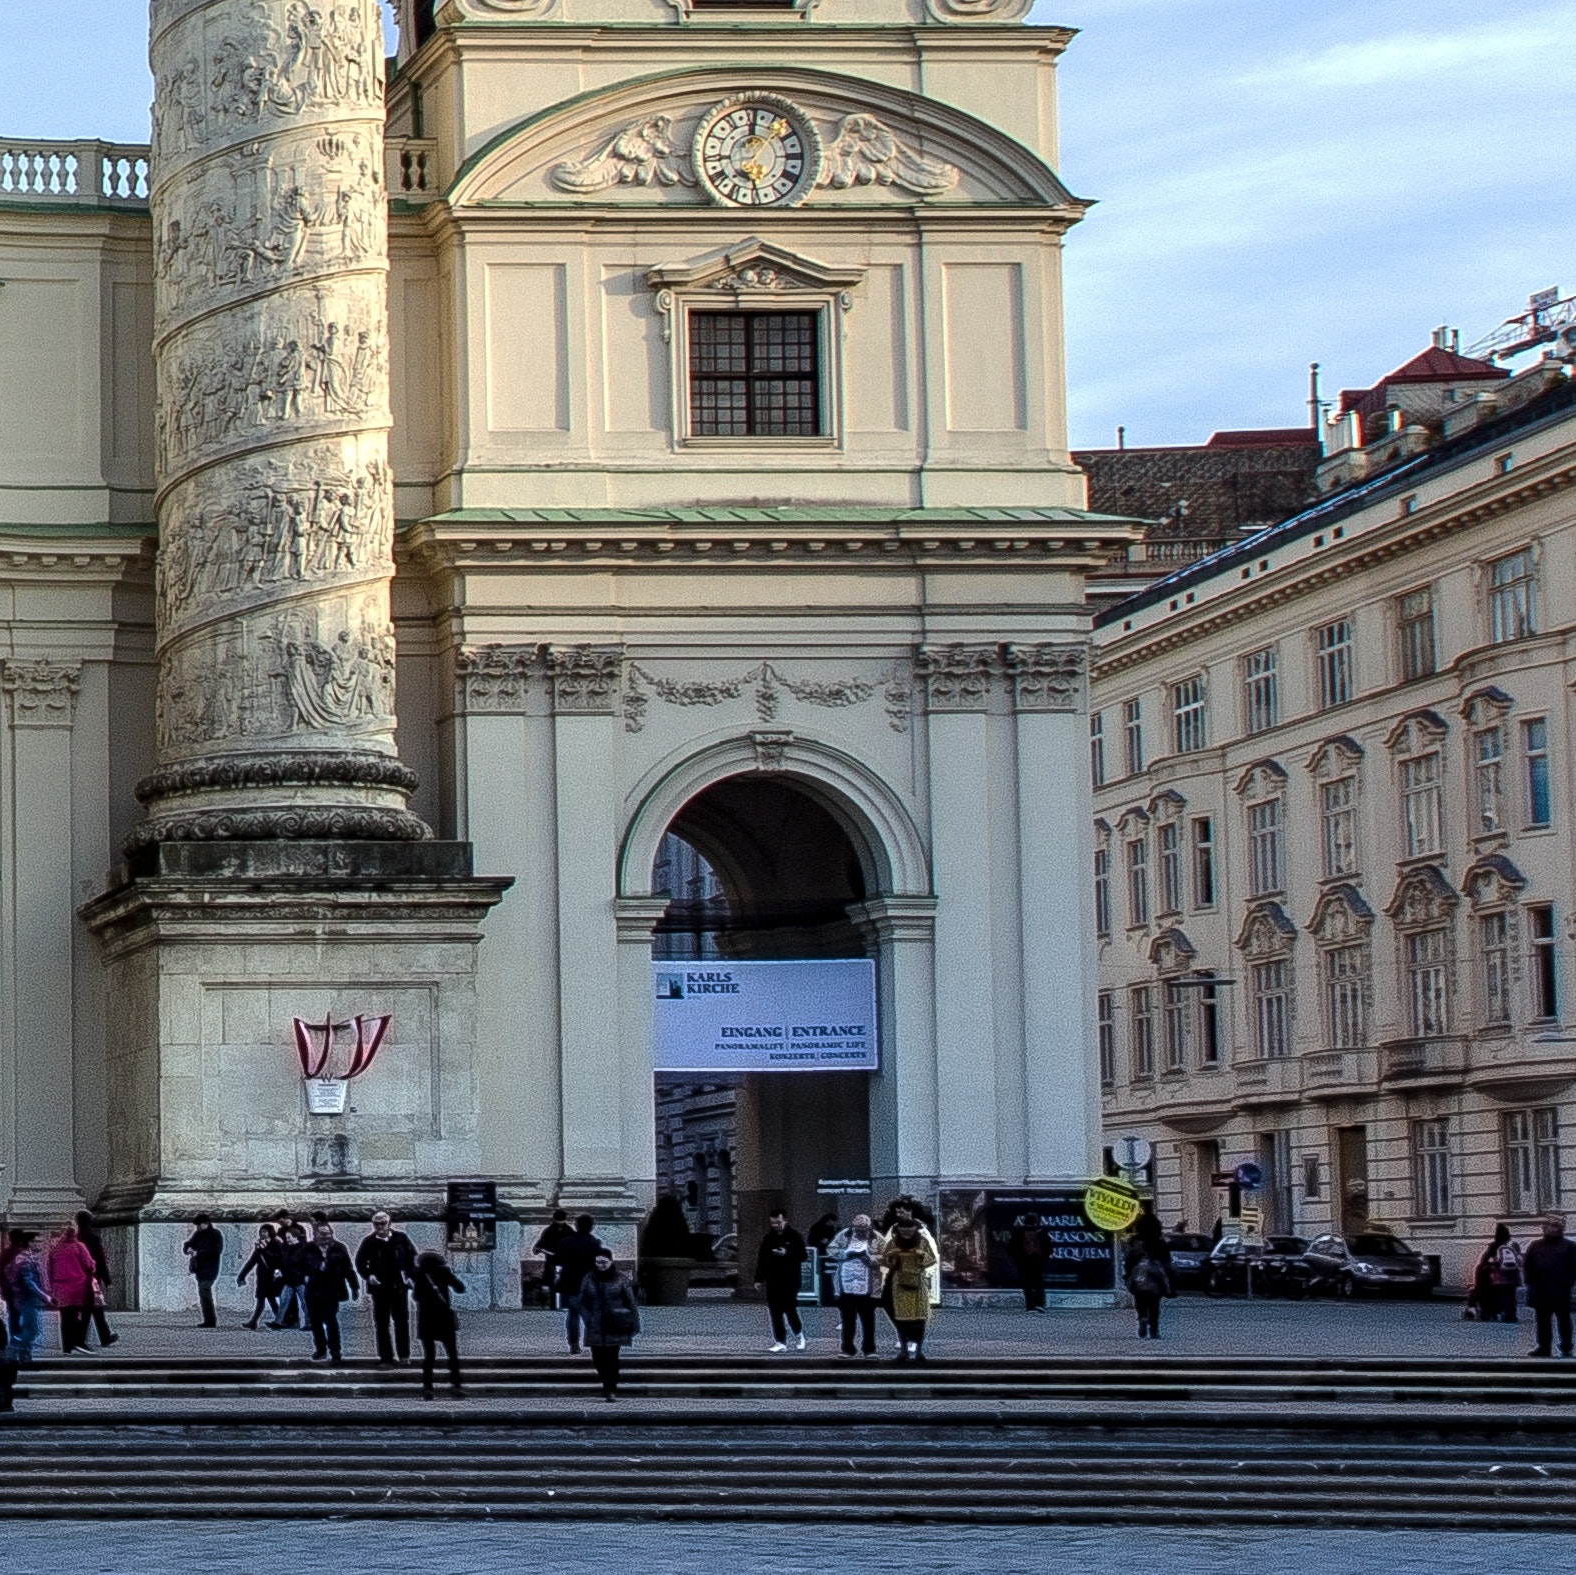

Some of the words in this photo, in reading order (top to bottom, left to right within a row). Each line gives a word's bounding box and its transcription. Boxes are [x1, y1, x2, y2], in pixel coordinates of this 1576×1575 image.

[686, 972, 733, 983] KARLS
[686, 983, 740, 994] KIRCHE
[721, 1026, 783, 1038] EINGANG
[792, 1025, 867, 1037] ENTRANCE
[1039, 1215, 1085, 1227] MARIA
[1048, 1230, 1105, 1243] SEASONS
